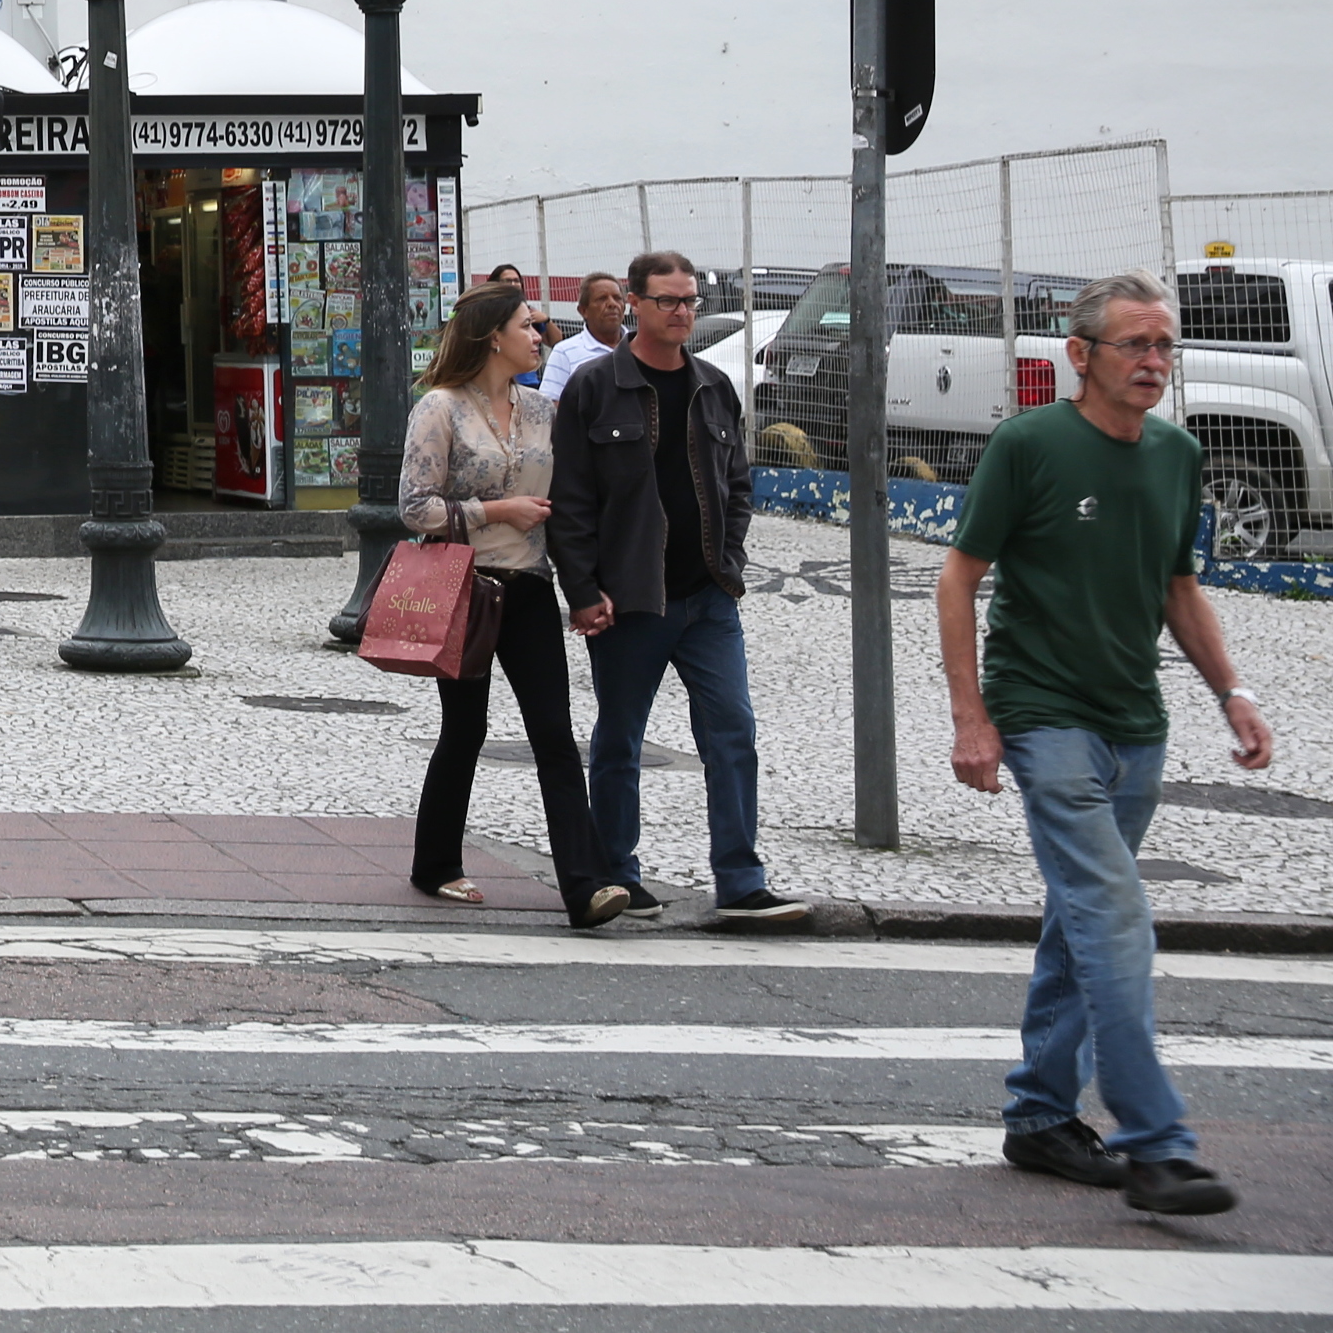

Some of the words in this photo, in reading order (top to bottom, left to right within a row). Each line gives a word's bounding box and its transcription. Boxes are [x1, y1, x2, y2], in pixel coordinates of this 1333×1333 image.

[20, 190, 44, 198] CASEIRO
[0, 237, 25, 259] PR
[325, 244, 360, 252] SALADAS
[23, 279, 60, 287] CONCURSO
[61, 277, 90, 288] PÚBLICO
[24, 290, 76, 301] PREFEITURA
[78, 291, 89, 301] DE
[32, 302, 81, 316] ARAUCÁRIA
[25, 318, 68, 326] APOSTILAS
[69, 318, 89, 327] AQUI
[36, 342, 86, 364] IBG
[0, 358, 25, 366] CURITIBA
[36, 364, 82, 372] APOSTILAS
[330, 439, 361, 448] SALADA
[388, 594, 437, 617] Squalle
